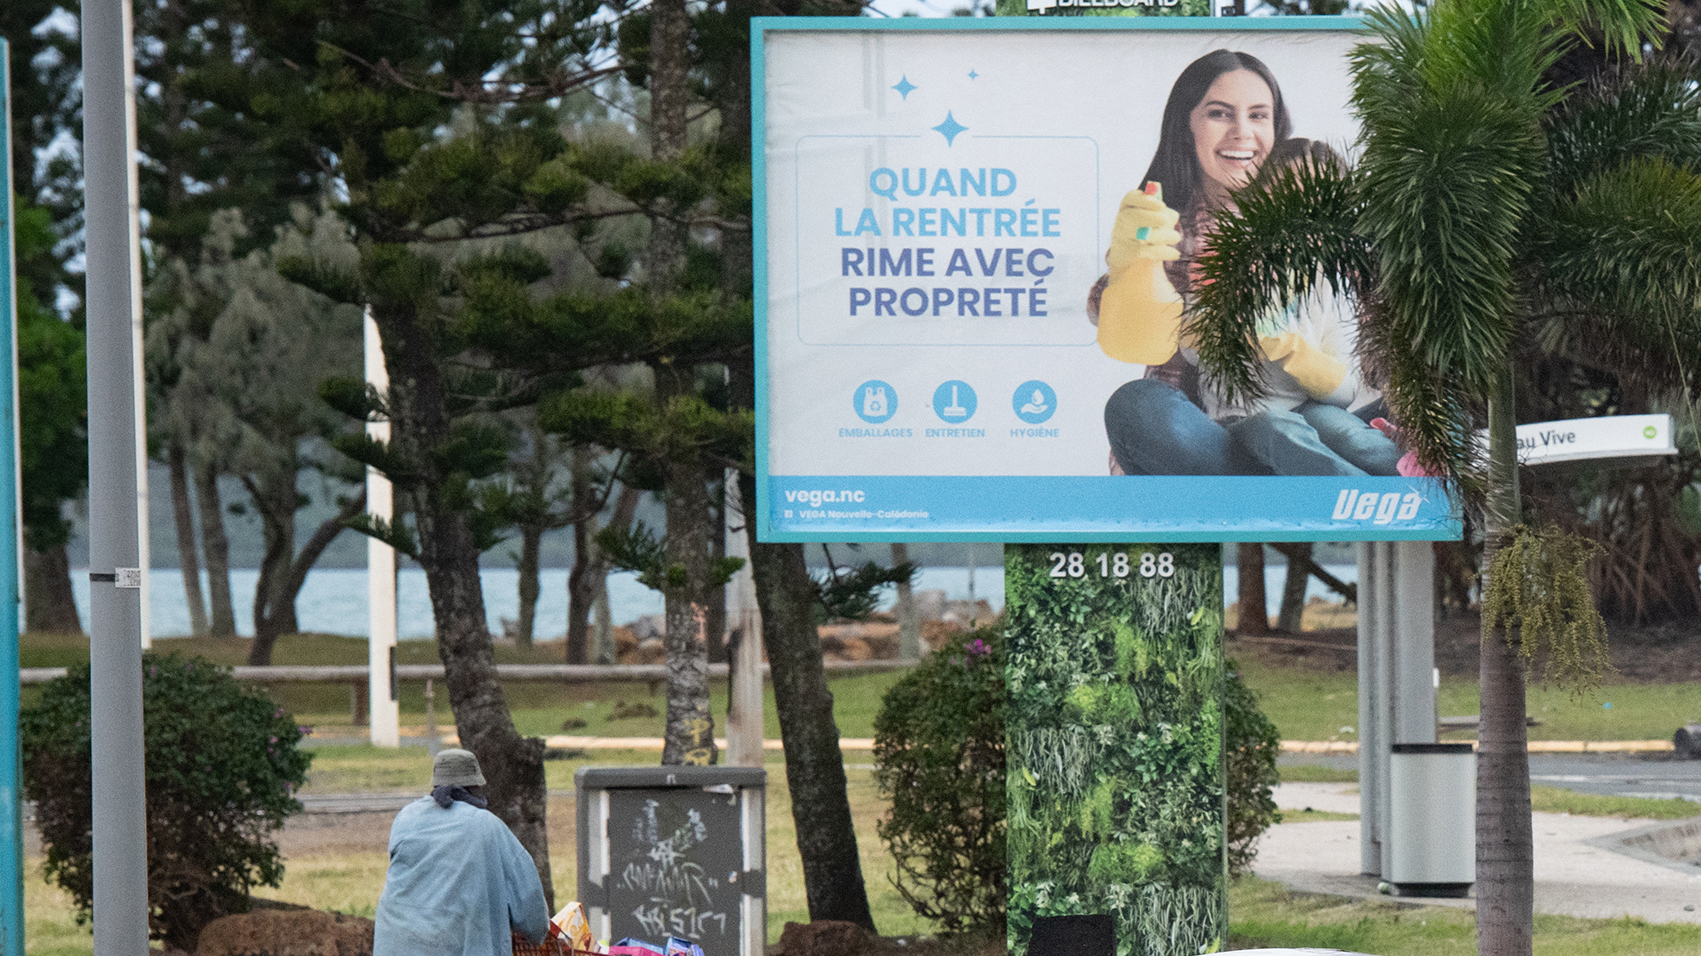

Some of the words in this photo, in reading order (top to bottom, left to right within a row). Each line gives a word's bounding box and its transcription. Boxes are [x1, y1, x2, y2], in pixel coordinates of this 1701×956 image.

[869, 167, 1017, 201] QUAND
[835, 207, 882, 237] LA
[892, 198, 1061, 237] RENTRÉE
[841, 248, 936, 277] RIME
[944, 247, 1055, 277] AVEC
[849, 278, 1048, 317] PROPRETÉ
[838, 428, 913, 438] EMBALLAGES
[925, 428, 986, 438] ENTRETIEN
[1010, 426, 1060, 438] HYGIÈNE
[1516, 437, 1536, 449] au
[1539, 429, 1576, 446] Vive
[785, 489, 866, 508] vega.nc
[1331, 489, 1424, 525] Vega
[799, 510, 826, 518] VEGA
[1049, 552, 1085, 578] 28
[1095, 552, 1130, 578] 18
[1139, 552, 1175, 578] 88
